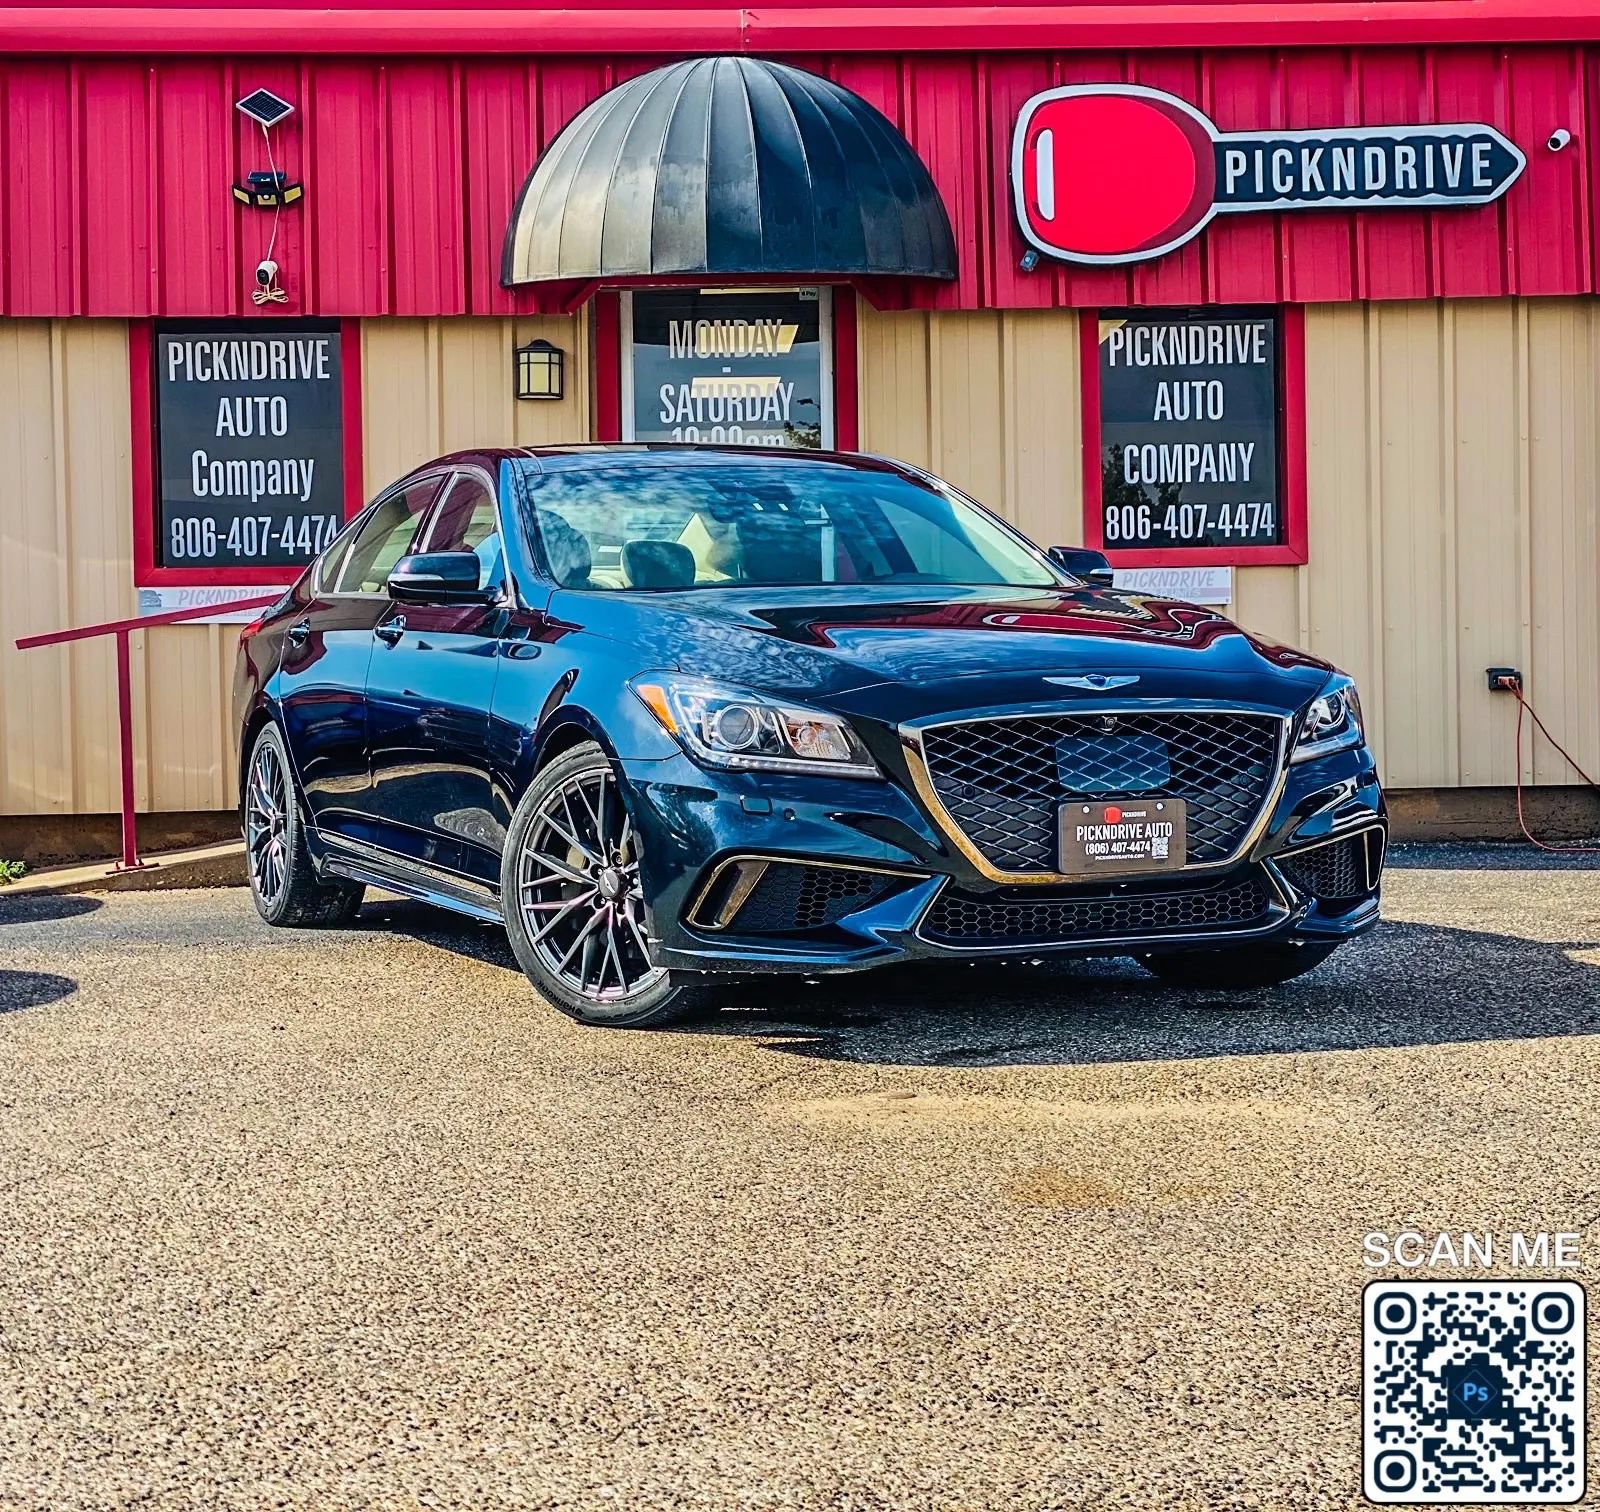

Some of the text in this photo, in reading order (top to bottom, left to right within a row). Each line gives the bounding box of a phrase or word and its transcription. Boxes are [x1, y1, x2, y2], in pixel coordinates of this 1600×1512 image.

[1225, 142, 1494, 195] PICKNDRIVE
[669, 318, 783, 359] MONDAY
[1108, 324, 1266, 367] PICKNDRIVE
[167, 339, 331, 382] PICKNDRIVE
[215, 396, 288, 437] AUTO
[659, 382, 795, 423] SATURDAY
[1153, 380, 1225, 421] AUTO
[191, 450, 315, 503] Company
[1123, 442, 1255, 485] COMPANY
[171, 515, 338, 558] 806-407-4474
[1106, 502, 1276, 541] 806-407-4474
[1122, 570, 1216, 588] PICKNDRIVE
[1076, 822, 1173, 841] PICKNDRIVE AUTO
[1085, 841, 1150, 855] (806) 407-4474
